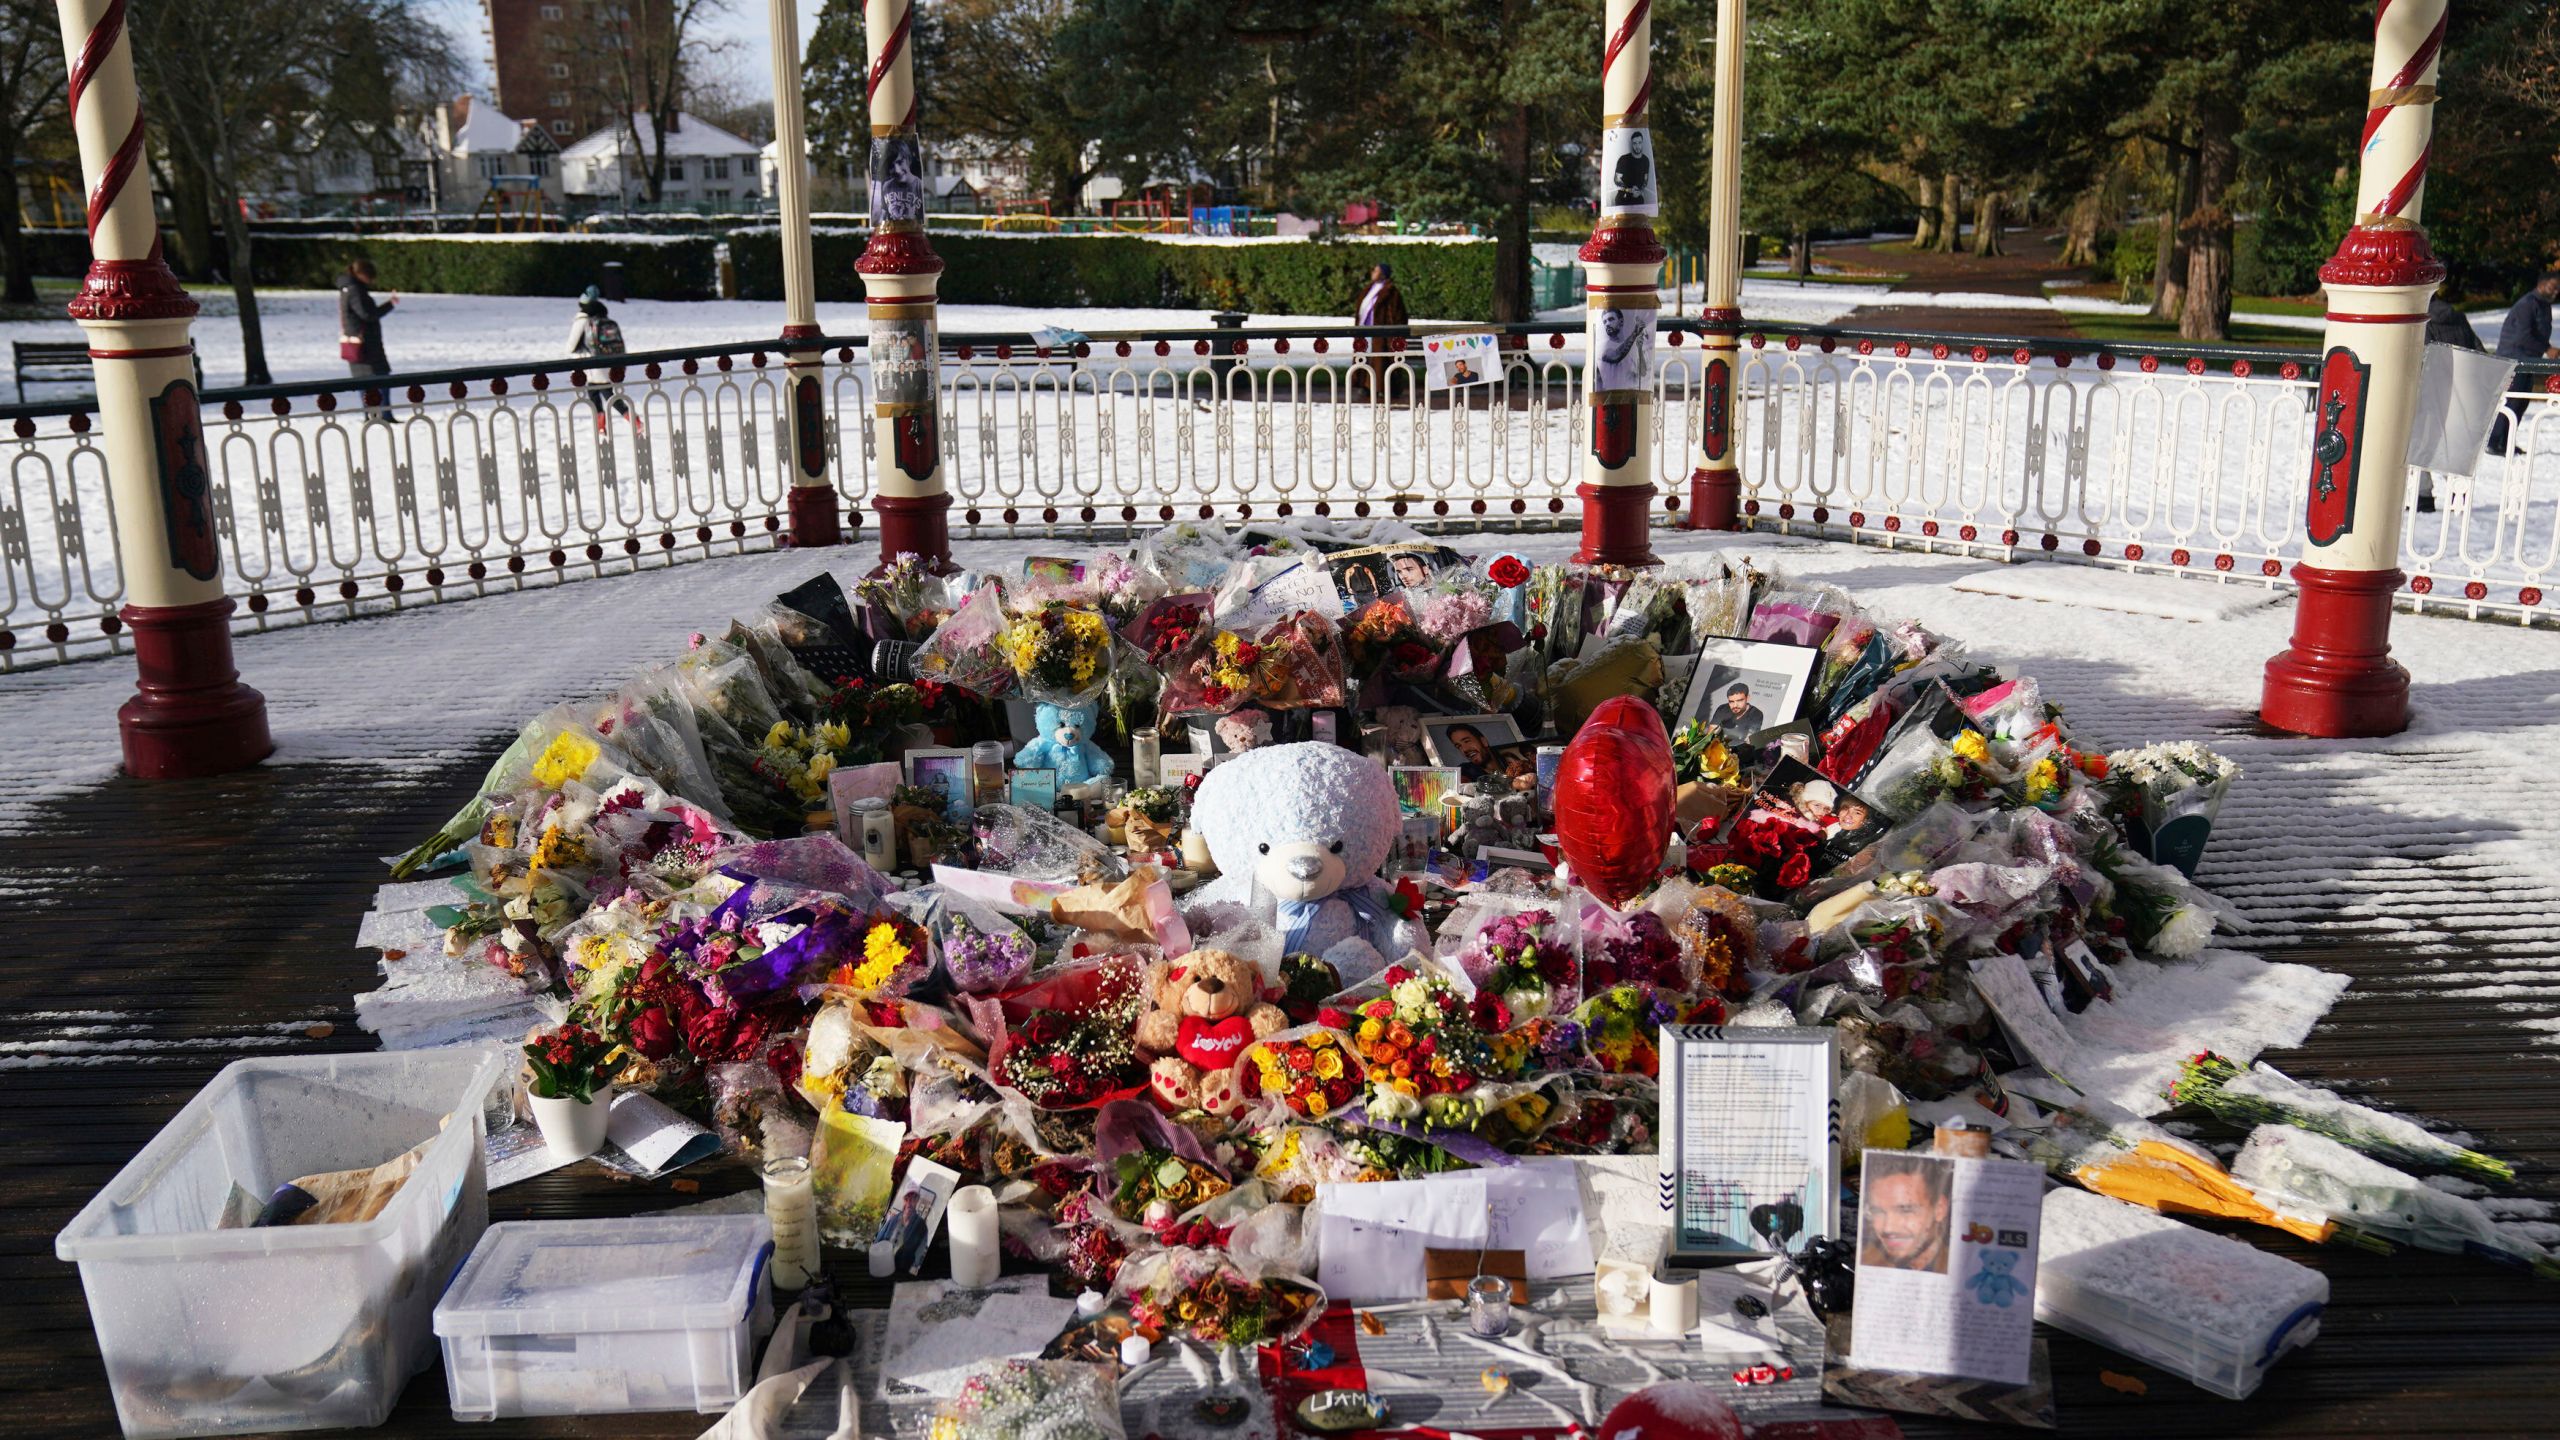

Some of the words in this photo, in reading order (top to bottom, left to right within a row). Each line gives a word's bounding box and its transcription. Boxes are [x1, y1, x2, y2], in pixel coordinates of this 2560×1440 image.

[884, 191, 922, 209] HENLEYS
[1296, 585, 1324, 598] NOT
[1191, 1032, 1202, 1048] I
[1213, 1031, 1242, 1051] YOU
[2001, 1233, 2026, 1246] JLS
